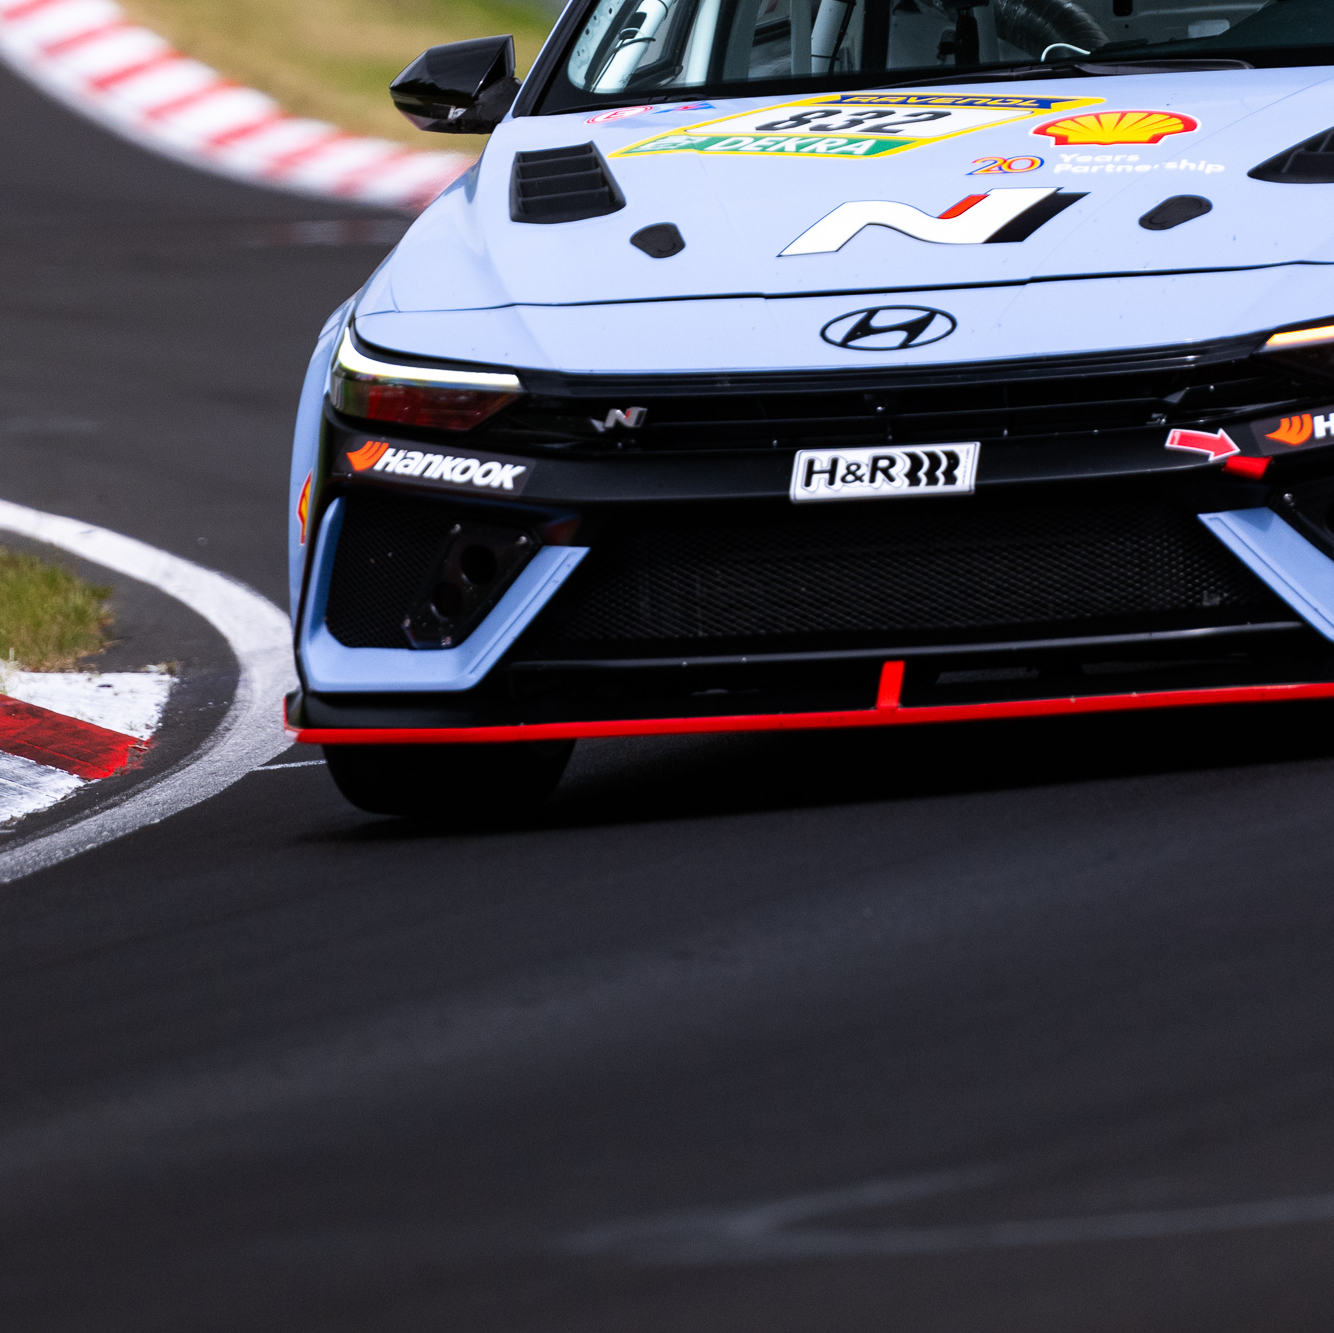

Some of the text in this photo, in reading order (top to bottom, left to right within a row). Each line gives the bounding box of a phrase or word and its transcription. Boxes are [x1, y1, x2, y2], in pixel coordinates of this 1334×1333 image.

[841, 96, 1040, 107] RAVENOL
[754, 109, 954, 136] 832
[703, 136, 878, 156] DEKRA
[964, 153, 1141, 176] 20 Years
[803, 453, 898, 489] H&R
